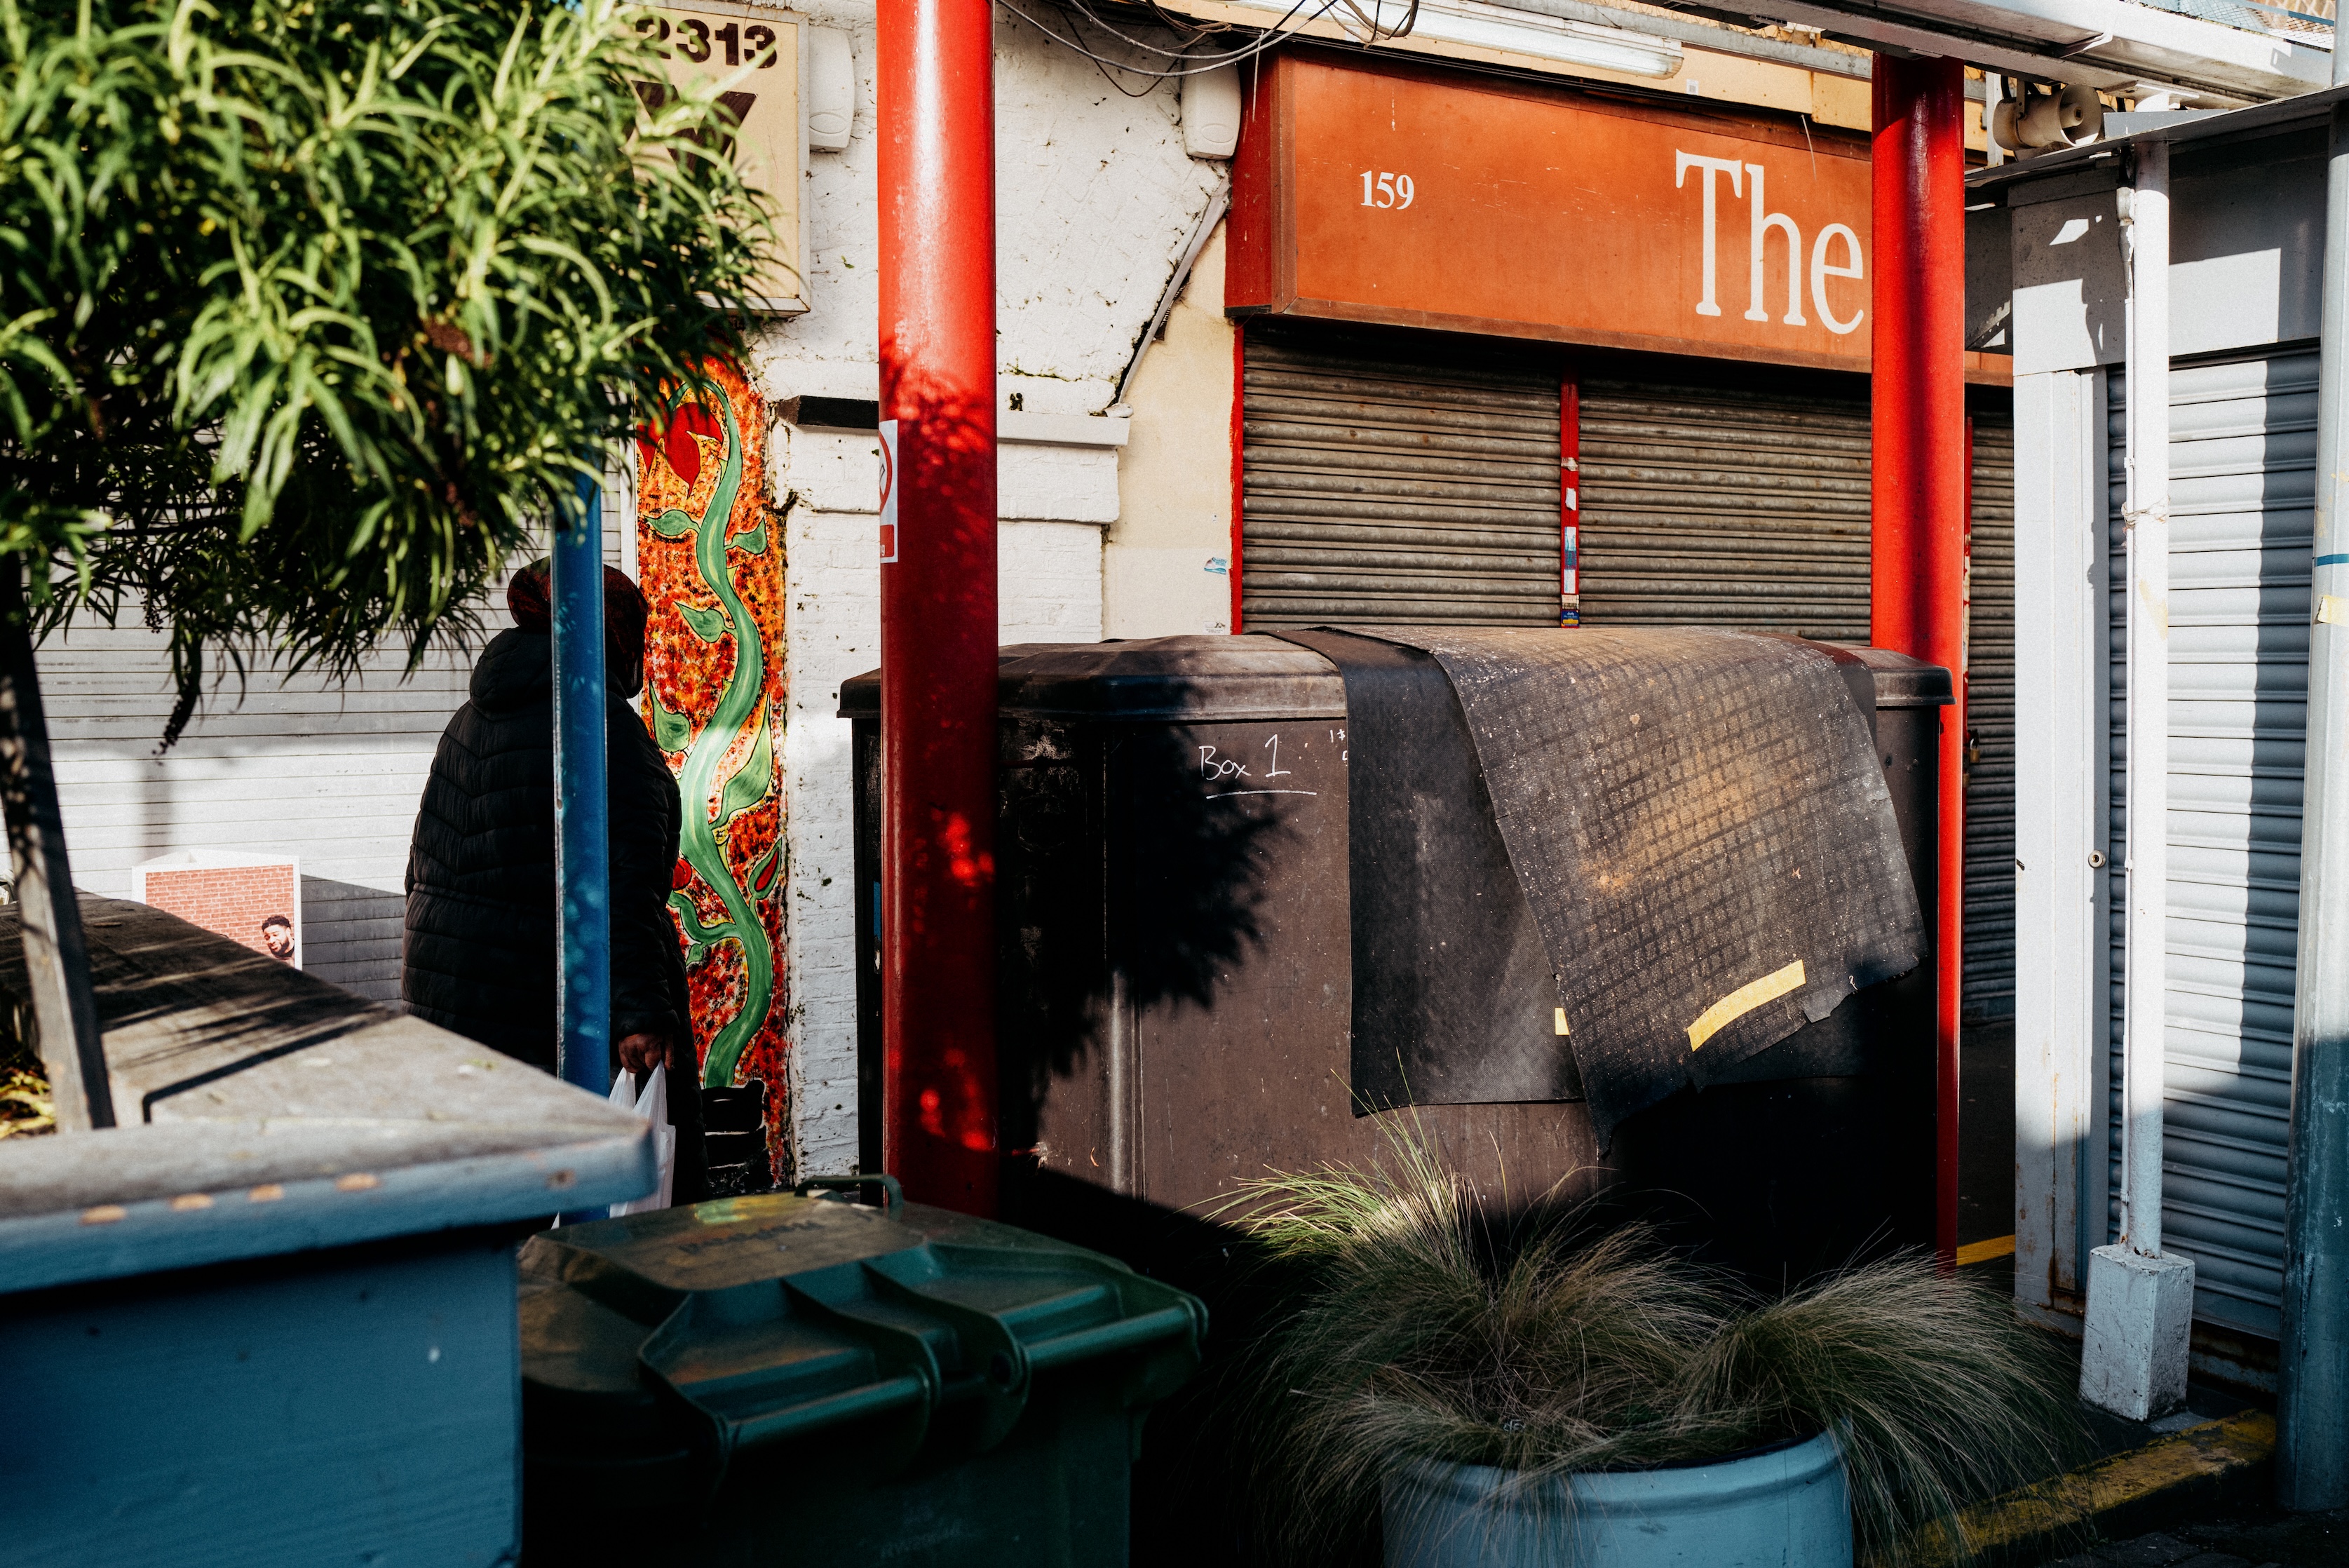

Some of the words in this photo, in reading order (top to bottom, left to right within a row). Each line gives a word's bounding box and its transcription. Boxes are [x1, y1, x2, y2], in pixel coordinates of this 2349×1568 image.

[635, 15, 778, 69] 2313
[1359, 170, 1415, 210] 159
[1675, 148, 1864, 335] The
[1198, 745, 1252, 780] Box
[1264, 734, 1292, 778] 1
